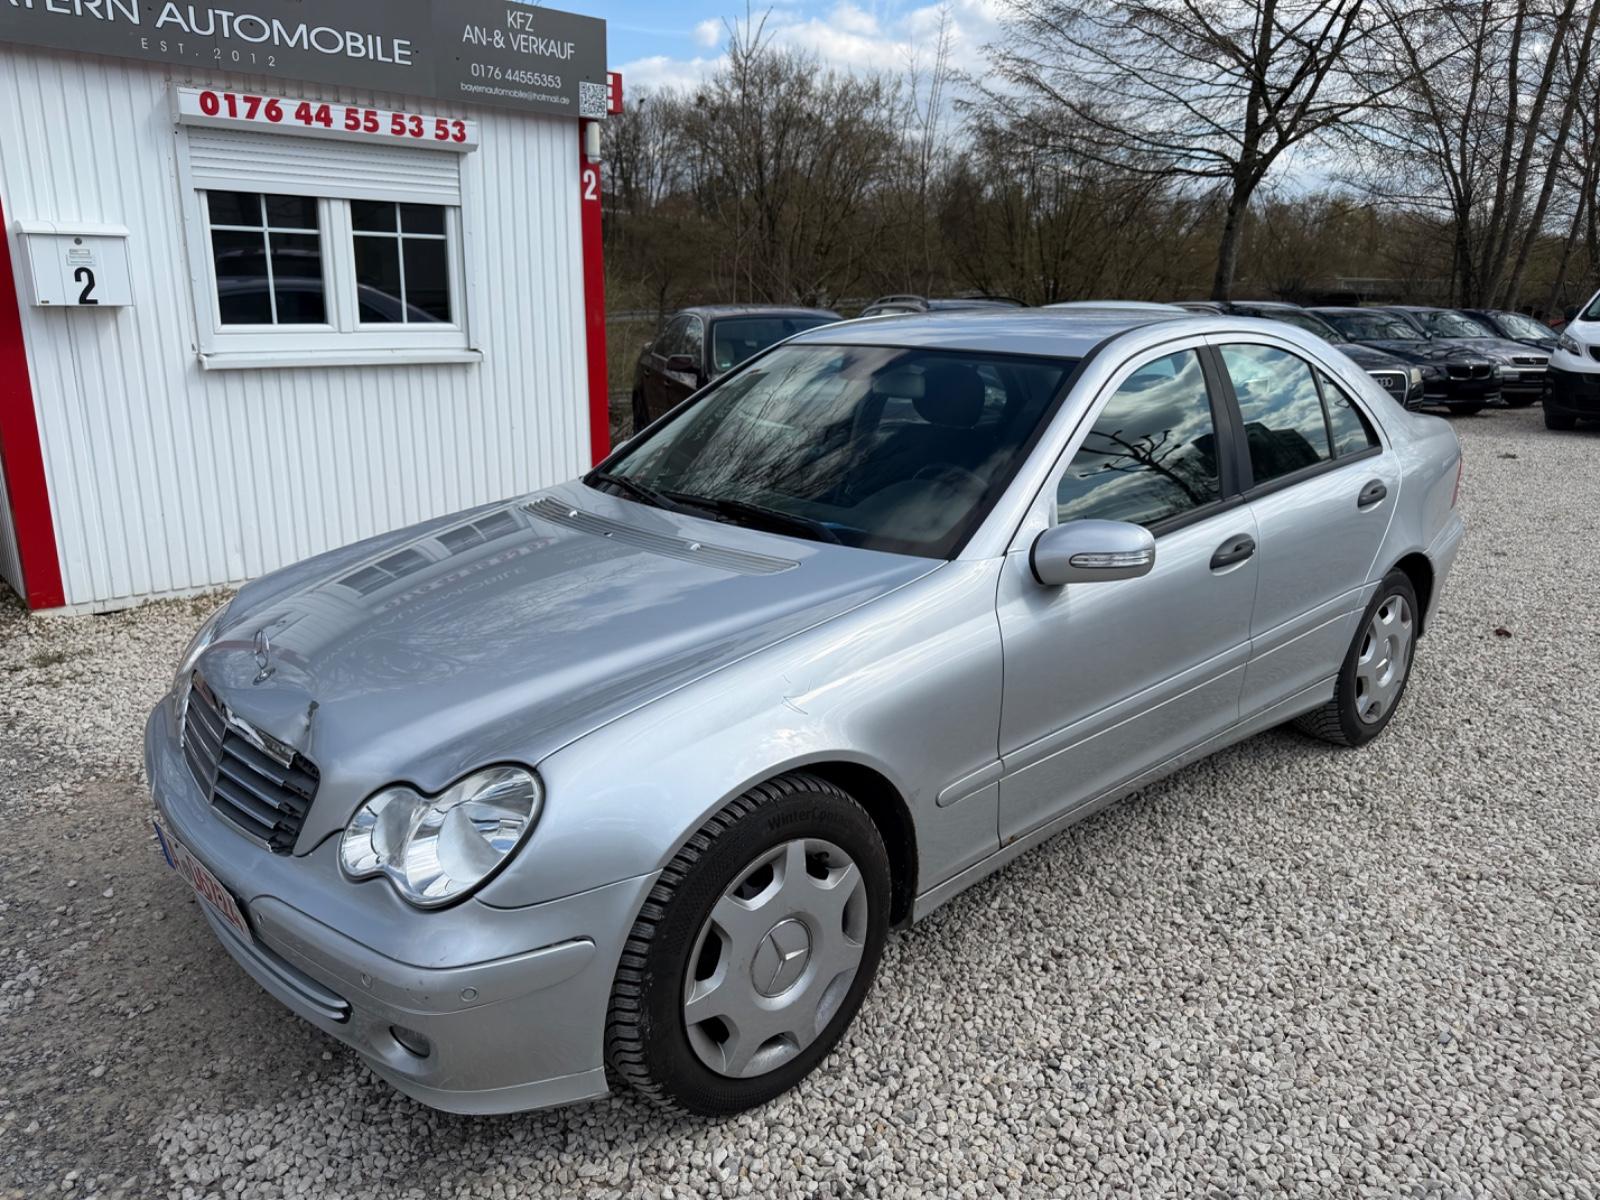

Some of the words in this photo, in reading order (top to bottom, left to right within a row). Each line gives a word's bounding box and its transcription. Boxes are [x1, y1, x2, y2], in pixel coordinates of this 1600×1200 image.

[156, 2, 413, 66] AUTOMOBILE
[507, 9, 534, 32] KFZ
[509, 32, 575, 60] VERKAUF
[471, 63, 502, 80] 0176
[505, 69, 562, 89] 44555353
[460, 82, 570, 105] bayernautomobile@hotmail.de
[199, 90, 283, 122] 0176
[294, 102, 333, 128] 44
[345, 107, 379, 133] 55
[391, 112, 424, 138] 53
[434, 118, 467, 143] 53
[583, 169, 597, 200] 2
[74, 267, 98, 305] 2
